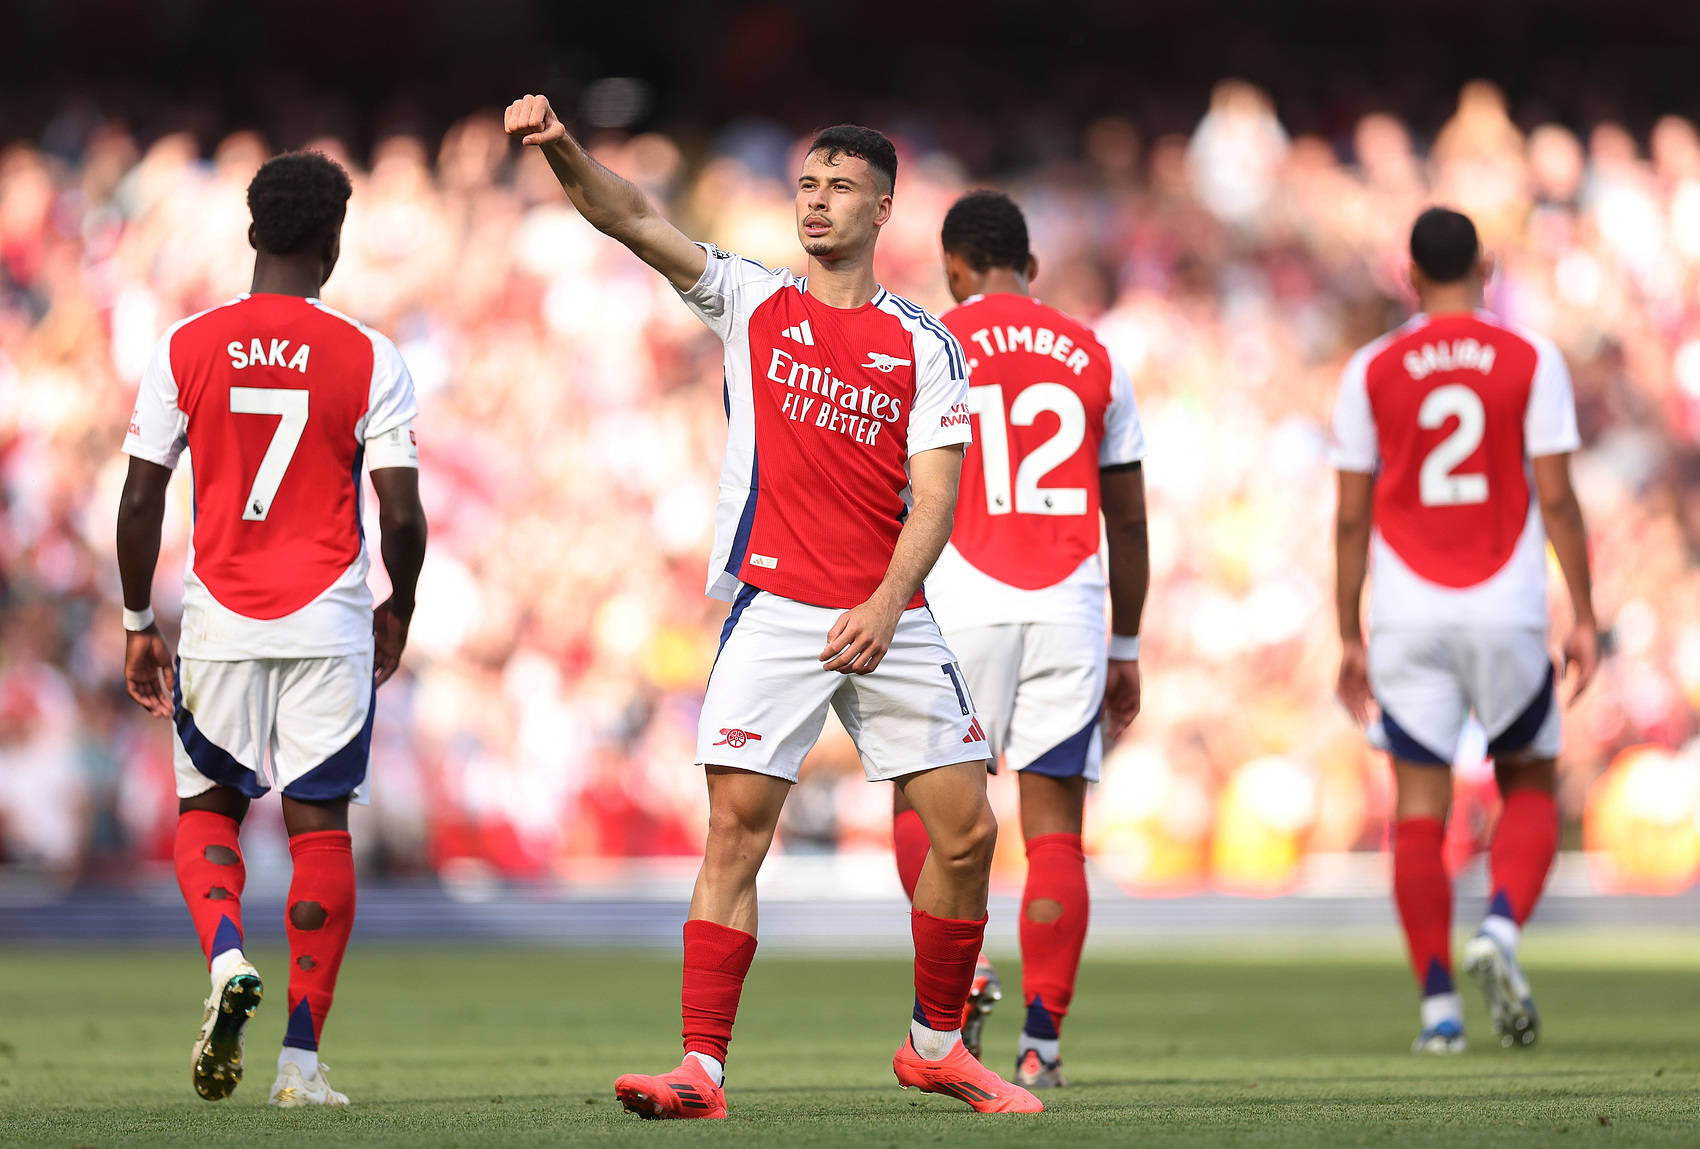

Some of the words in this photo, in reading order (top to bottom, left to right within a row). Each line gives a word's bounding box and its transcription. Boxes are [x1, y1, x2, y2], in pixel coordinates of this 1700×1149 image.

[227, 338, 310, 373] SAKA
[767, 347, 902, 423] Emirates
[971, 326, 1090, 375] TIMBER
[230, 386, 309, 521] 7
[782, 392, 816, 422] FLY
[816, 401, 882, 446] BETTER
[968, 382, 1087, 515] 12
[1417, 383, 1489, 507] 2
